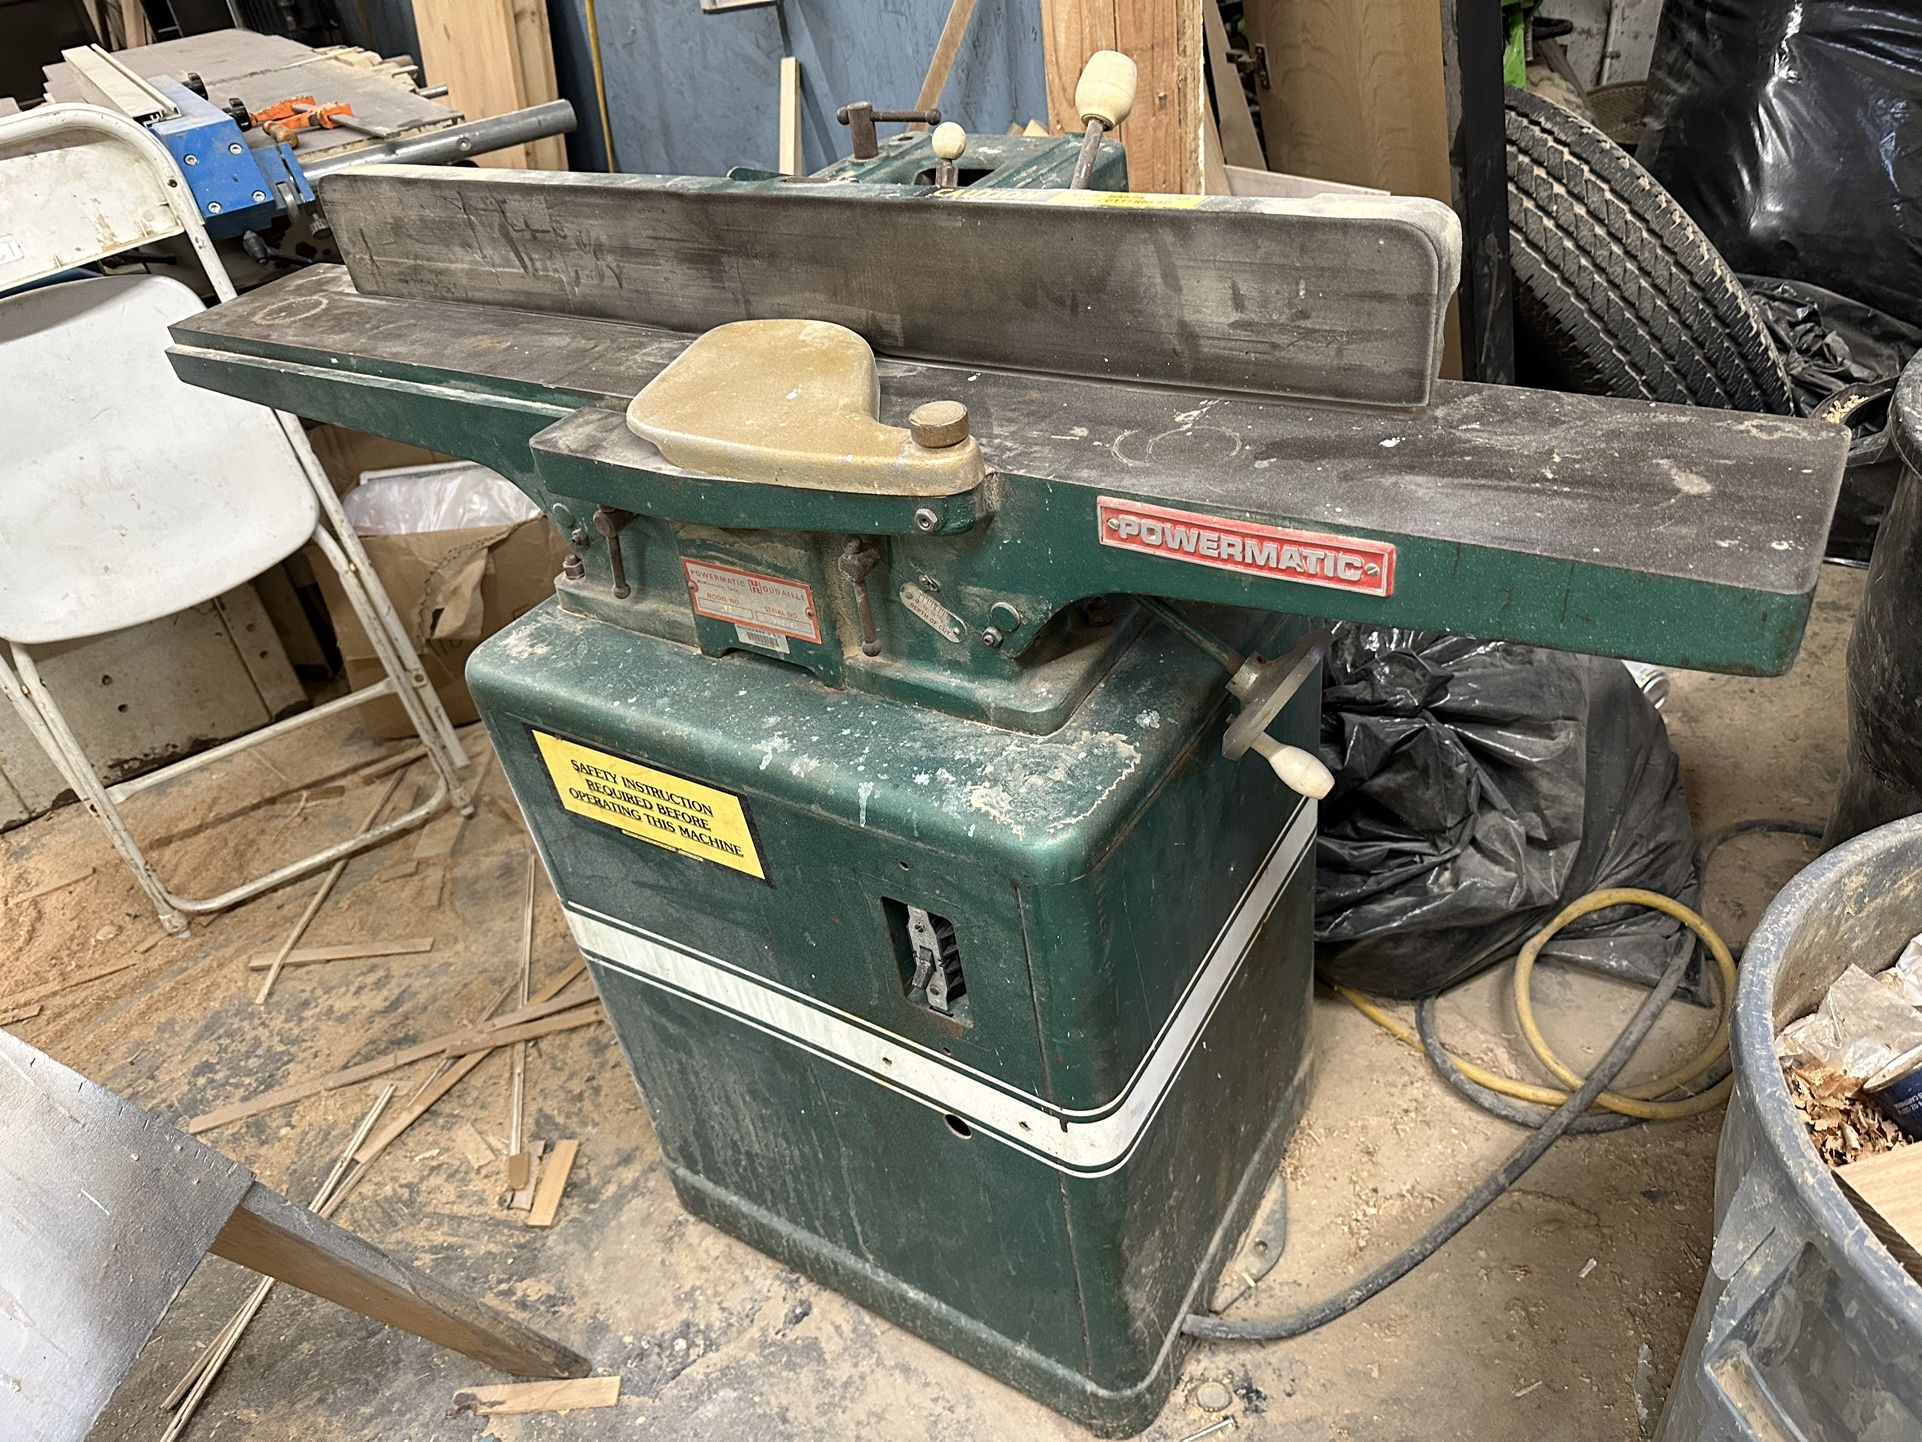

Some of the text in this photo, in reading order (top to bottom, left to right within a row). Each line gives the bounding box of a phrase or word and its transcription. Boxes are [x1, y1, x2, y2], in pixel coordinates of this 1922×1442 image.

[1118, 514, 1364, 582] POWERMATIC
[690, 569, 745, 586] POWERMATIC
[706, 592, 727, 603] MODEL
[765, 606, 785, 617] SERIAL
[909, 602, 929, 619] DEPTH
[938, 625, 950, 636] CUT
[570, 759, 714, 817] SAFETY INSTRUCTION
[585, 778, 712, 831] REQUIRED BEFORE
[568, 787, 745, 857] OPERATING THIS MACHINE
